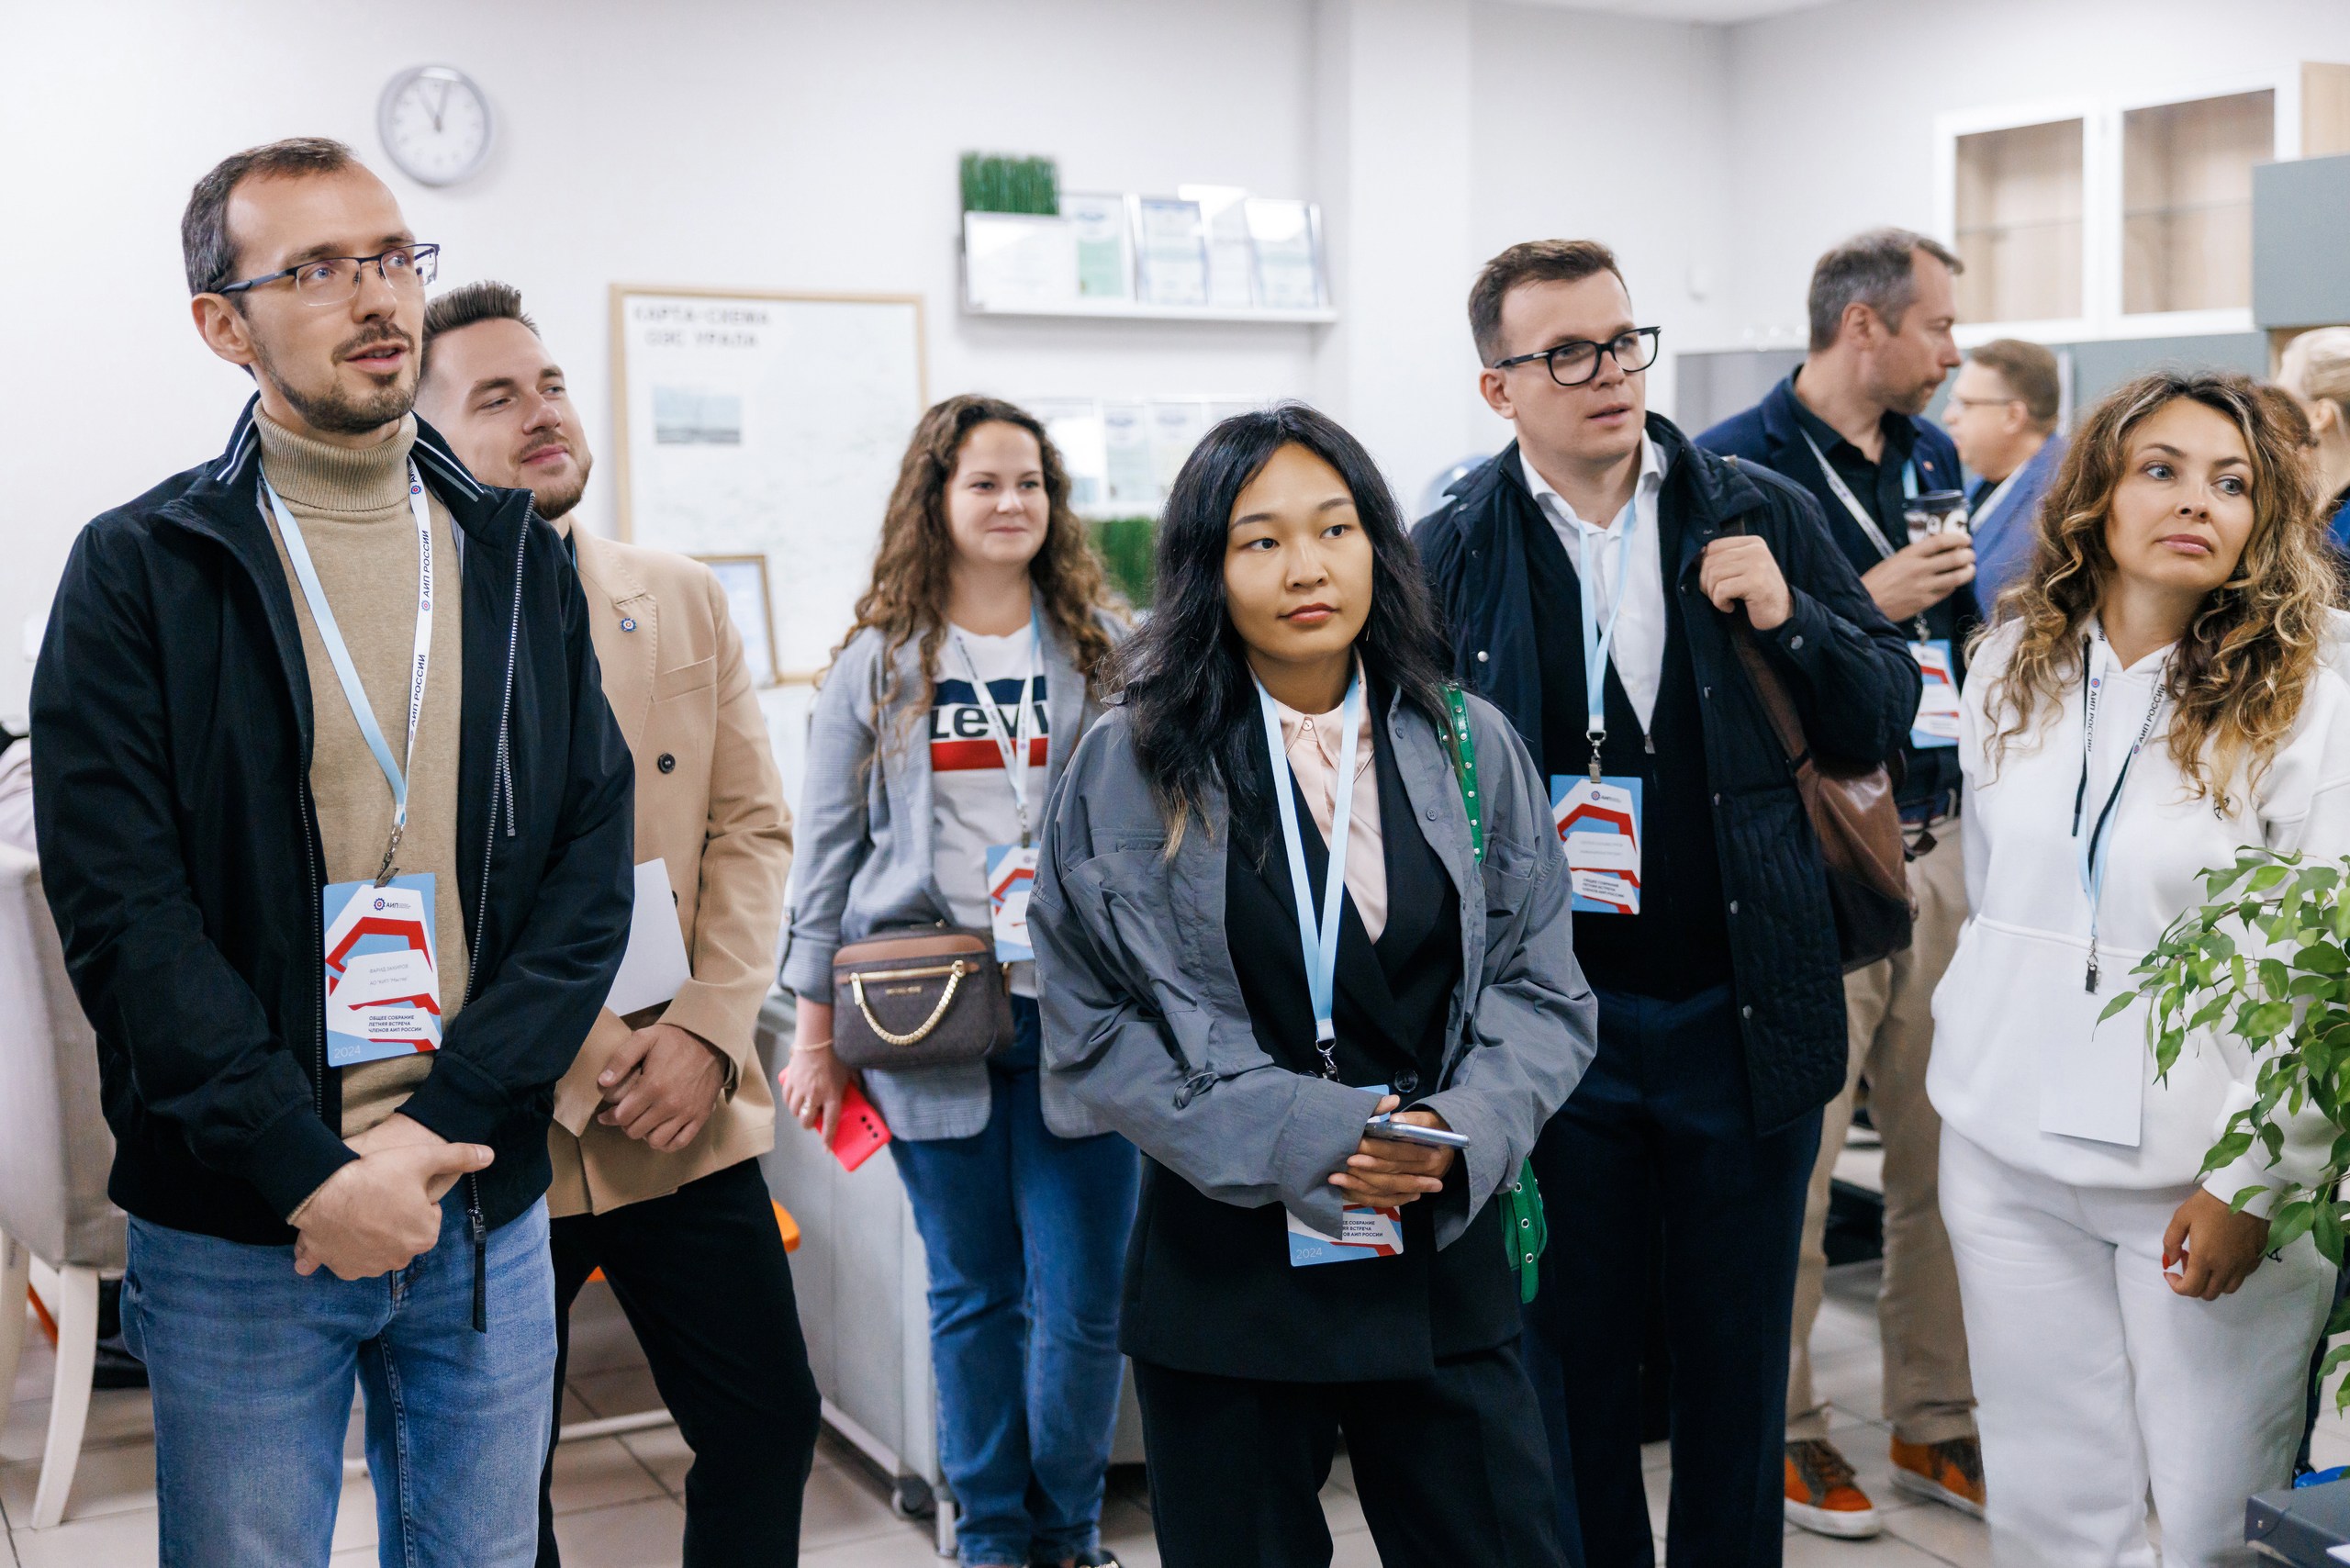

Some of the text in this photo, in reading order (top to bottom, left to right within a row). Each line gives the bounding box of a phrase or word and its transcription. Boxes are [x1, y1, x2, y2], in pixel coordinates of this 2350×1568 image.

[422, 530, 431, 573] РОССИИ
[414, 654, 426, 700] РОССИИ
[2087, 690, 2098, 752] АИП РОССИИ
[2139, 683, 2166, 743] АИП РОССИИ
[334, 1045, 361, 1058] 2024
[1295, 1247, 1322, 1259] 2024
